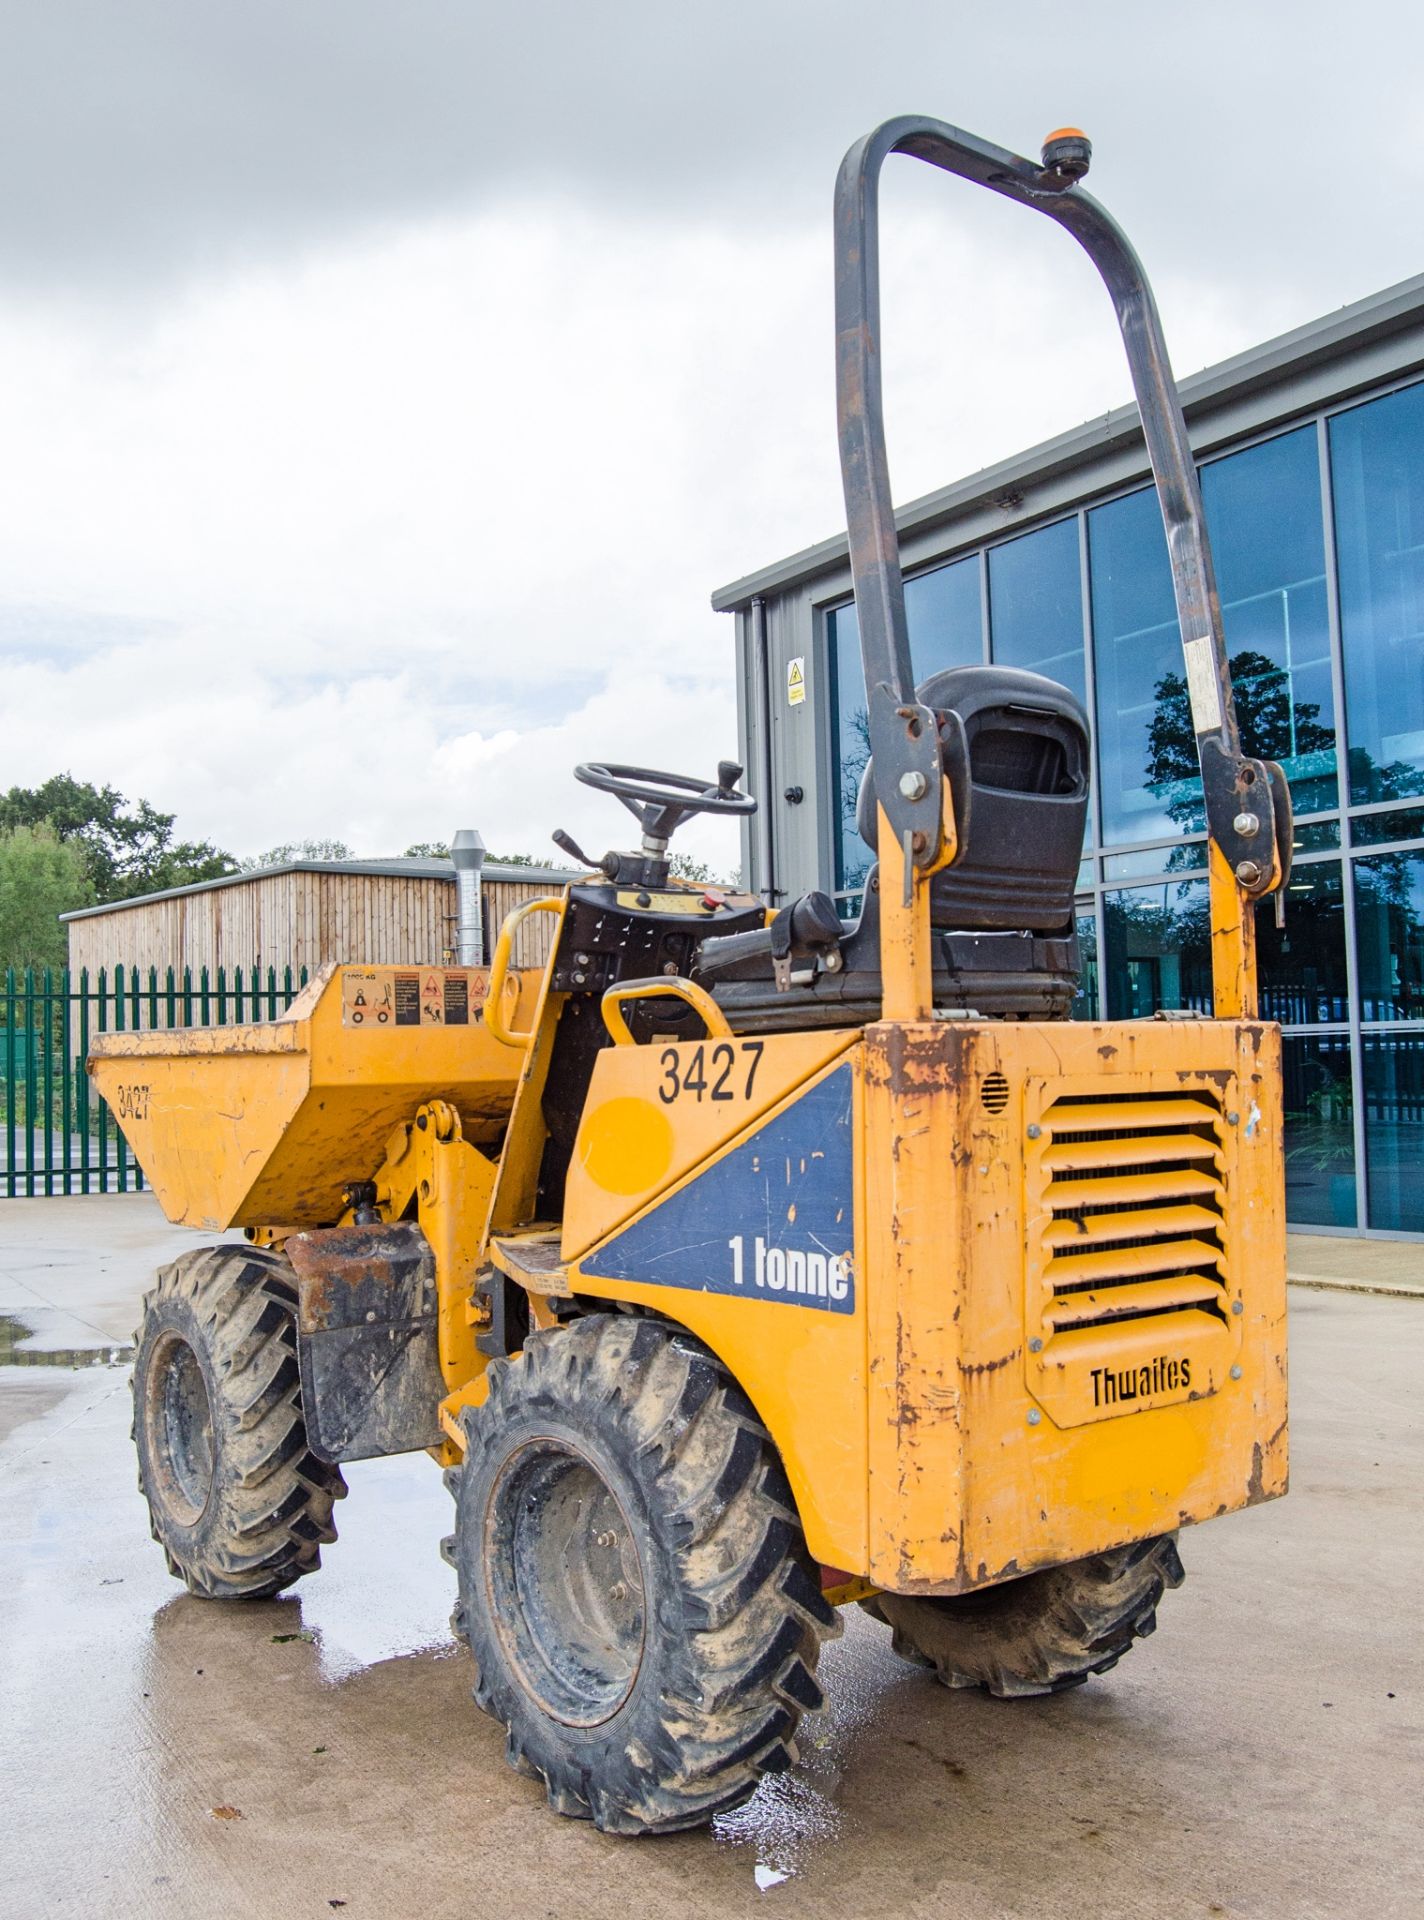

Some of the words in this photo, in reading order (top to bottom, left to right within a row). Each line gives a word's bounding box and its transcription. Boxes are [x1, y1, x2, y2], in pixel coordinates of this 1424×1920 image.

[658, 1041, 764, 1104] 3427
[728, 1235, 743, 1284] 1
[754, 1236, 850, 1300] tonne
[1090, 1355, 1191, 1407] Thwaites
